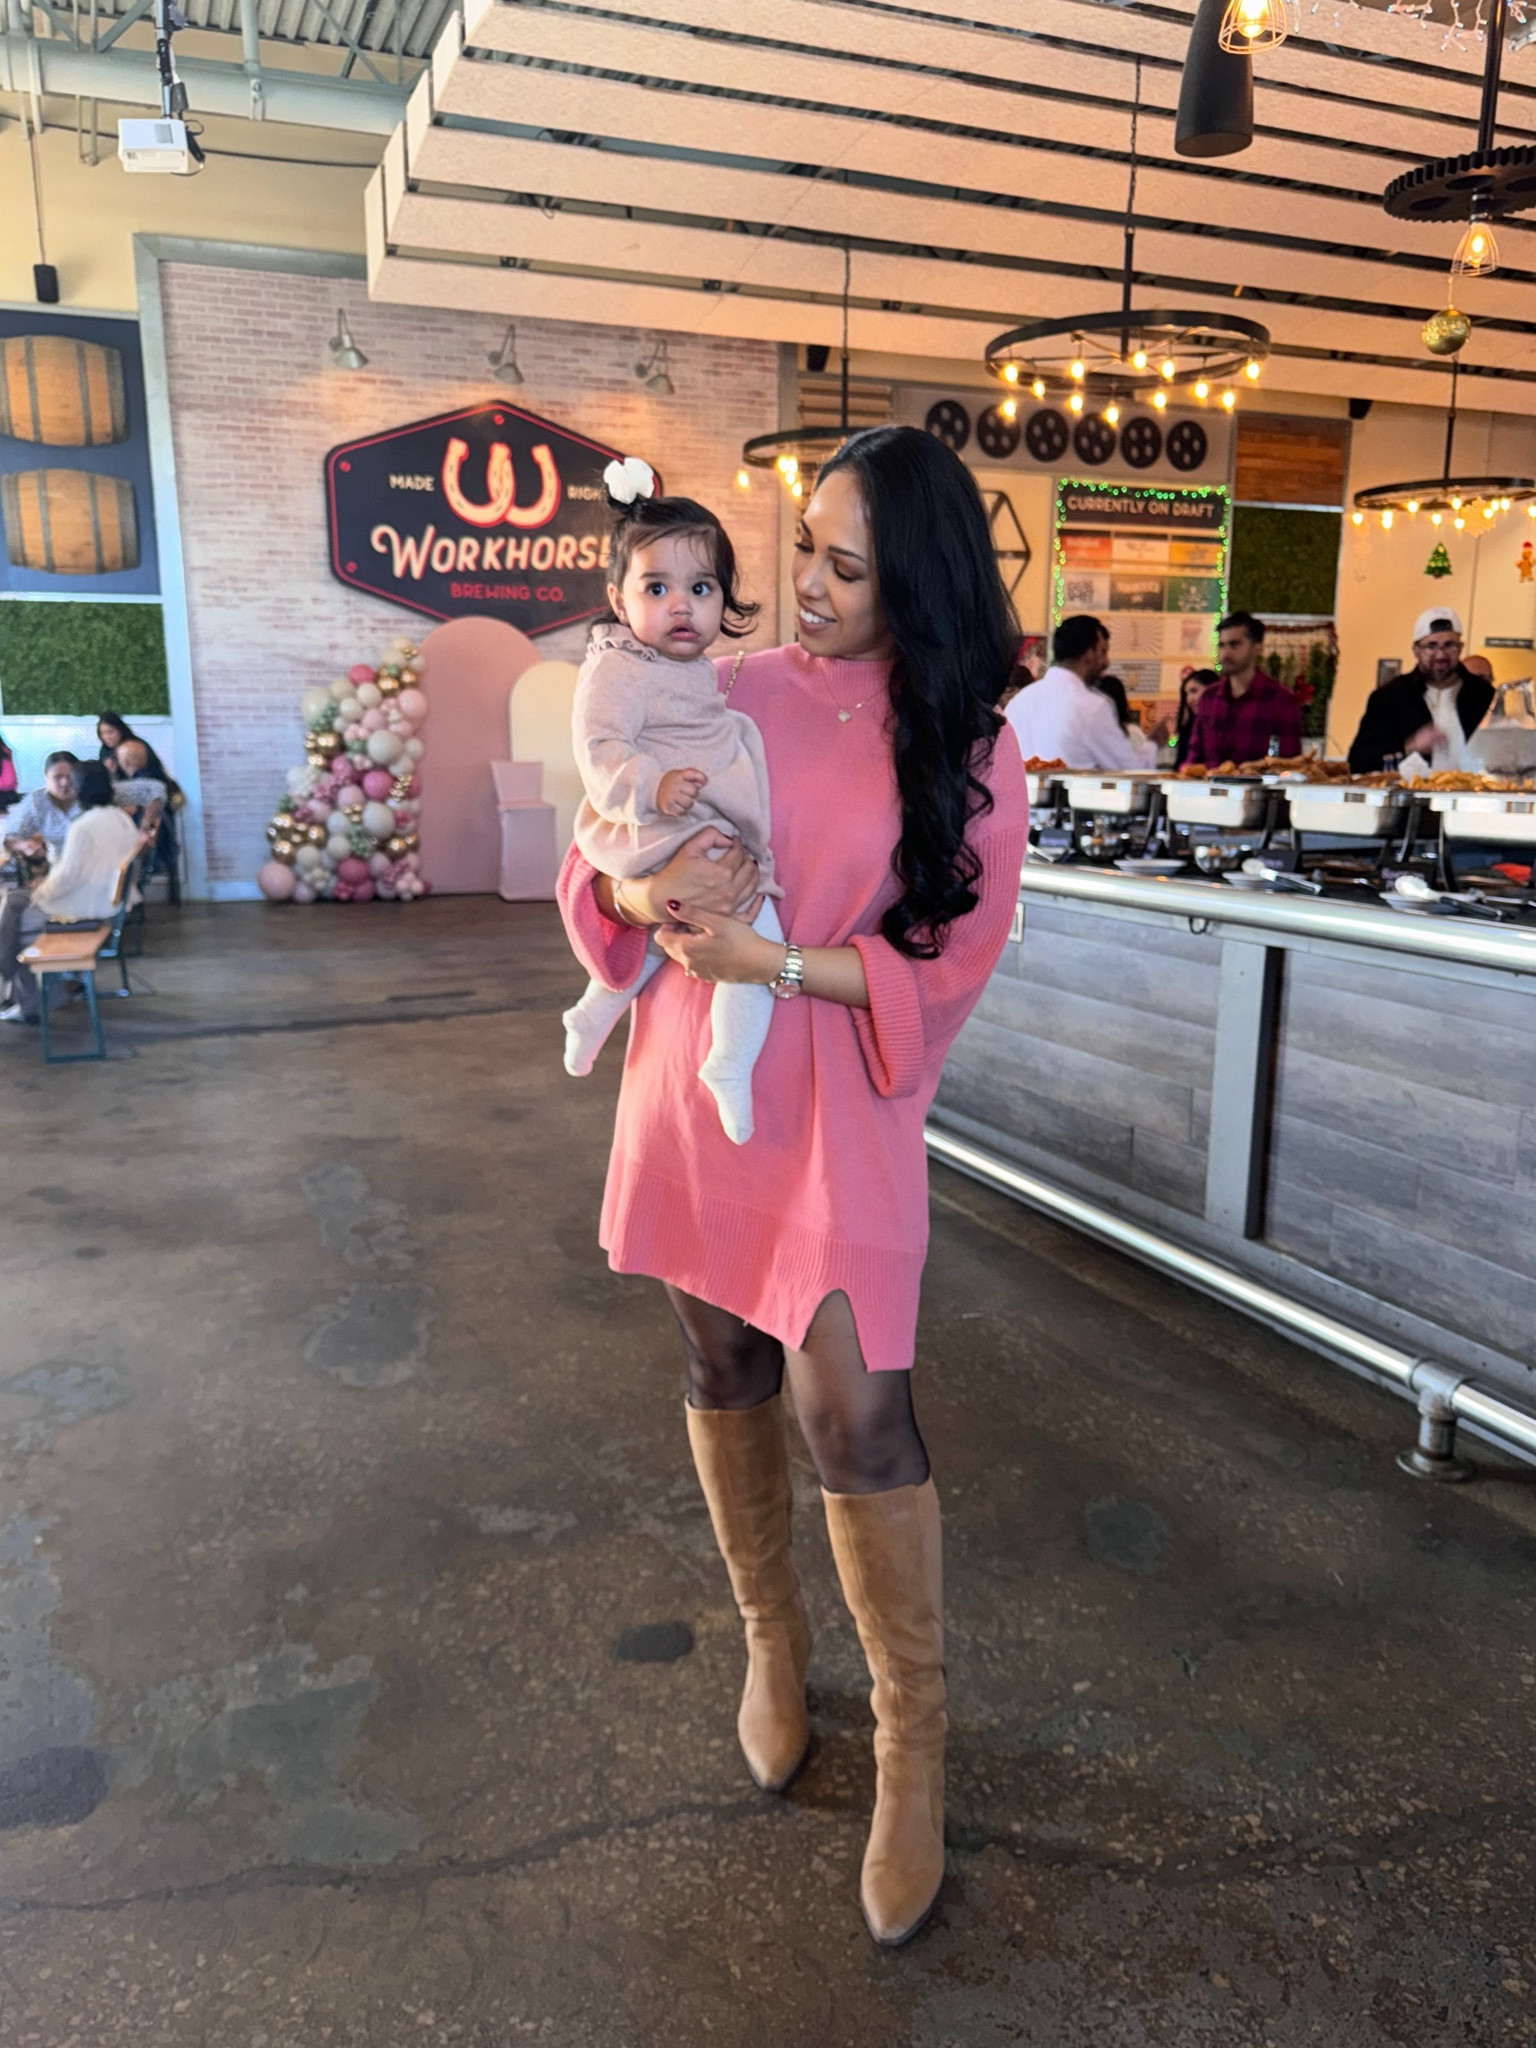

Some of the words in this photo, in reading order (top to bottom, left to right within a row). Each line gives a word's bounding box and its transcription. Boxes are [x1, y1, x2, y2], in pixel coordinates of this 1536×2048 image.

[389, 474, 434, 491] MADE
[1066, 496, 1144, 514] CURRENTLY
[1147, 503, 1168, 515] ON
[1172, 503, 1214, 518] DRAFT
[450, 582, 530, 600] BREWING
[536, 585, 566, 603] CO.
